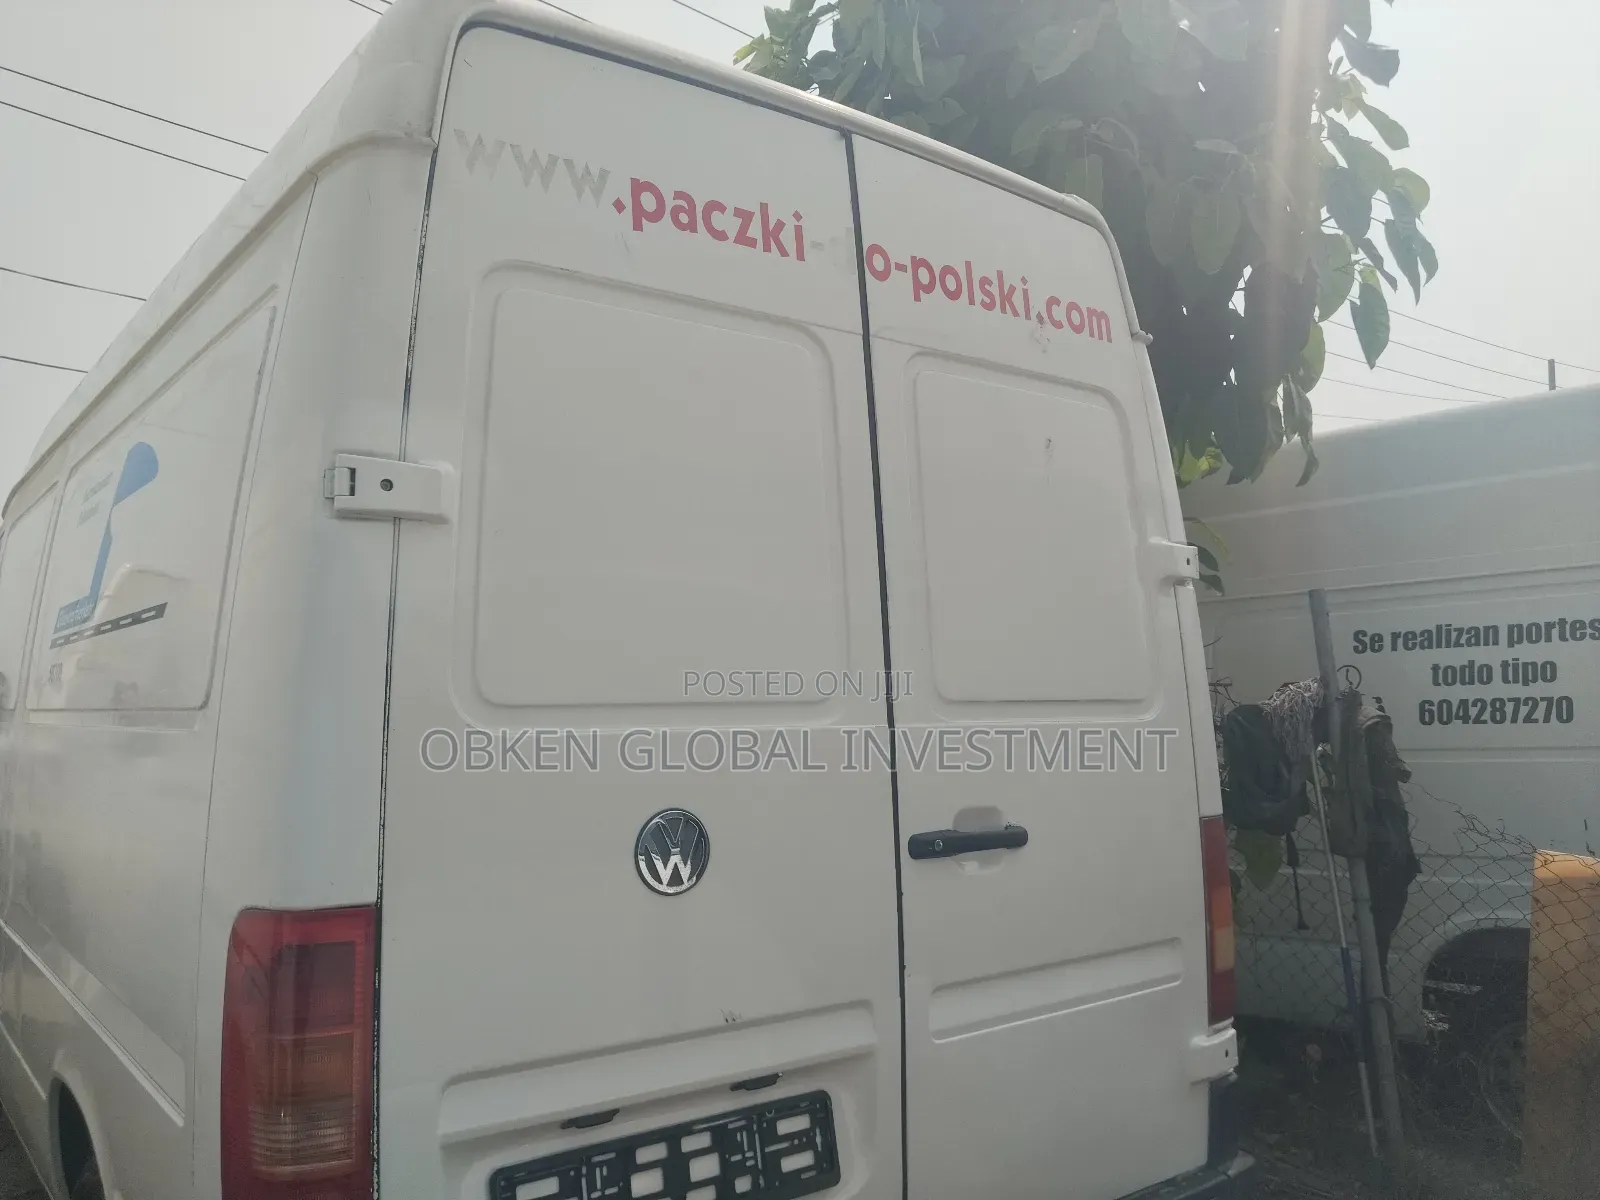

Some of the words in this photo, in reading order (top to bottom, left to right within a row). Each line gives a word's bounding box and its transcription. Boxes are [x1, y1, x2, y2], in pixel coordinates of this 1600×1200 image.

[1352, 629, 1384, 654] Se
[1390, 623, 1500, 652] realizan
[1507, 617, 1600, 648] portes
[1430, 660, 1493, 687] todo
[1500, 657, 1558, 687] tipo
[1418, 695, 1574, 726] 604287270
